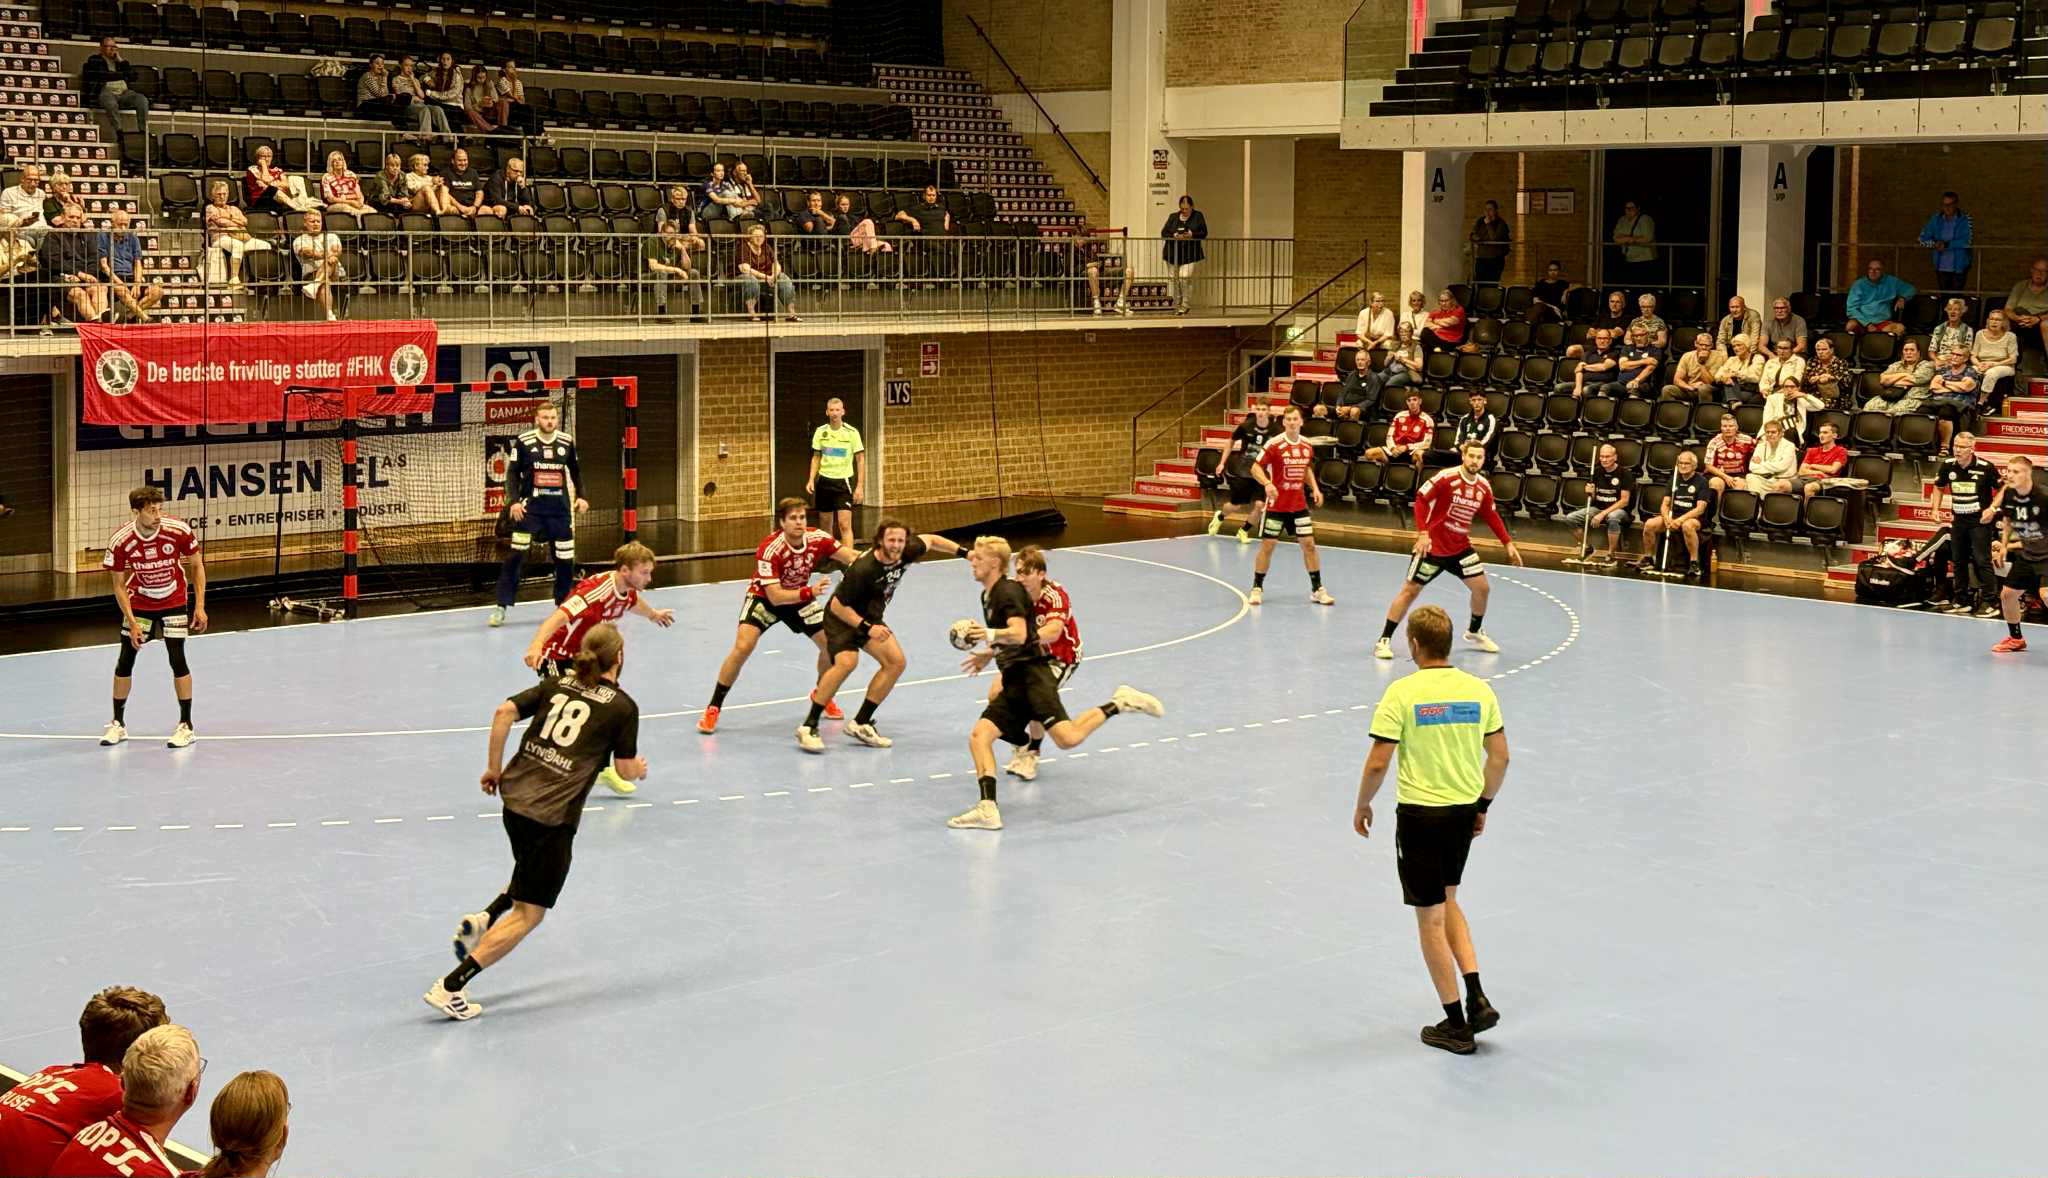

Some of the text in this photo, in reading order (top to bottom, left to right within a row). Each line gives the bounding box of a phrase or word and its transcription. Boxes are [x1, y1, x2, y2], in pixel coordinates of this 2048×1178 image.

[1432, 168, 1446, 193] A
[1773, 162, 1788, 189] A
[147, 361, 168, 382] De
[172, 360, 225, 382] bedste
[229, 357, 291, 385] frivillige
[295, 358, 343, 379] støtter
[346, 355, 384, 377] #FHK
[887, 382, 911, 403] LYS
[144, 459, 323, 502] HANSEN
[228, 508, 326, 527] ENTREPRISER
[357, 502, 406, 517] DUSTRI
[2016, 506, 2028, 520] 14
[133, 558, 176, 570] thansen
[539, 693, 591, 748] 18
[0, 1091, 37, 1112] RUSE
